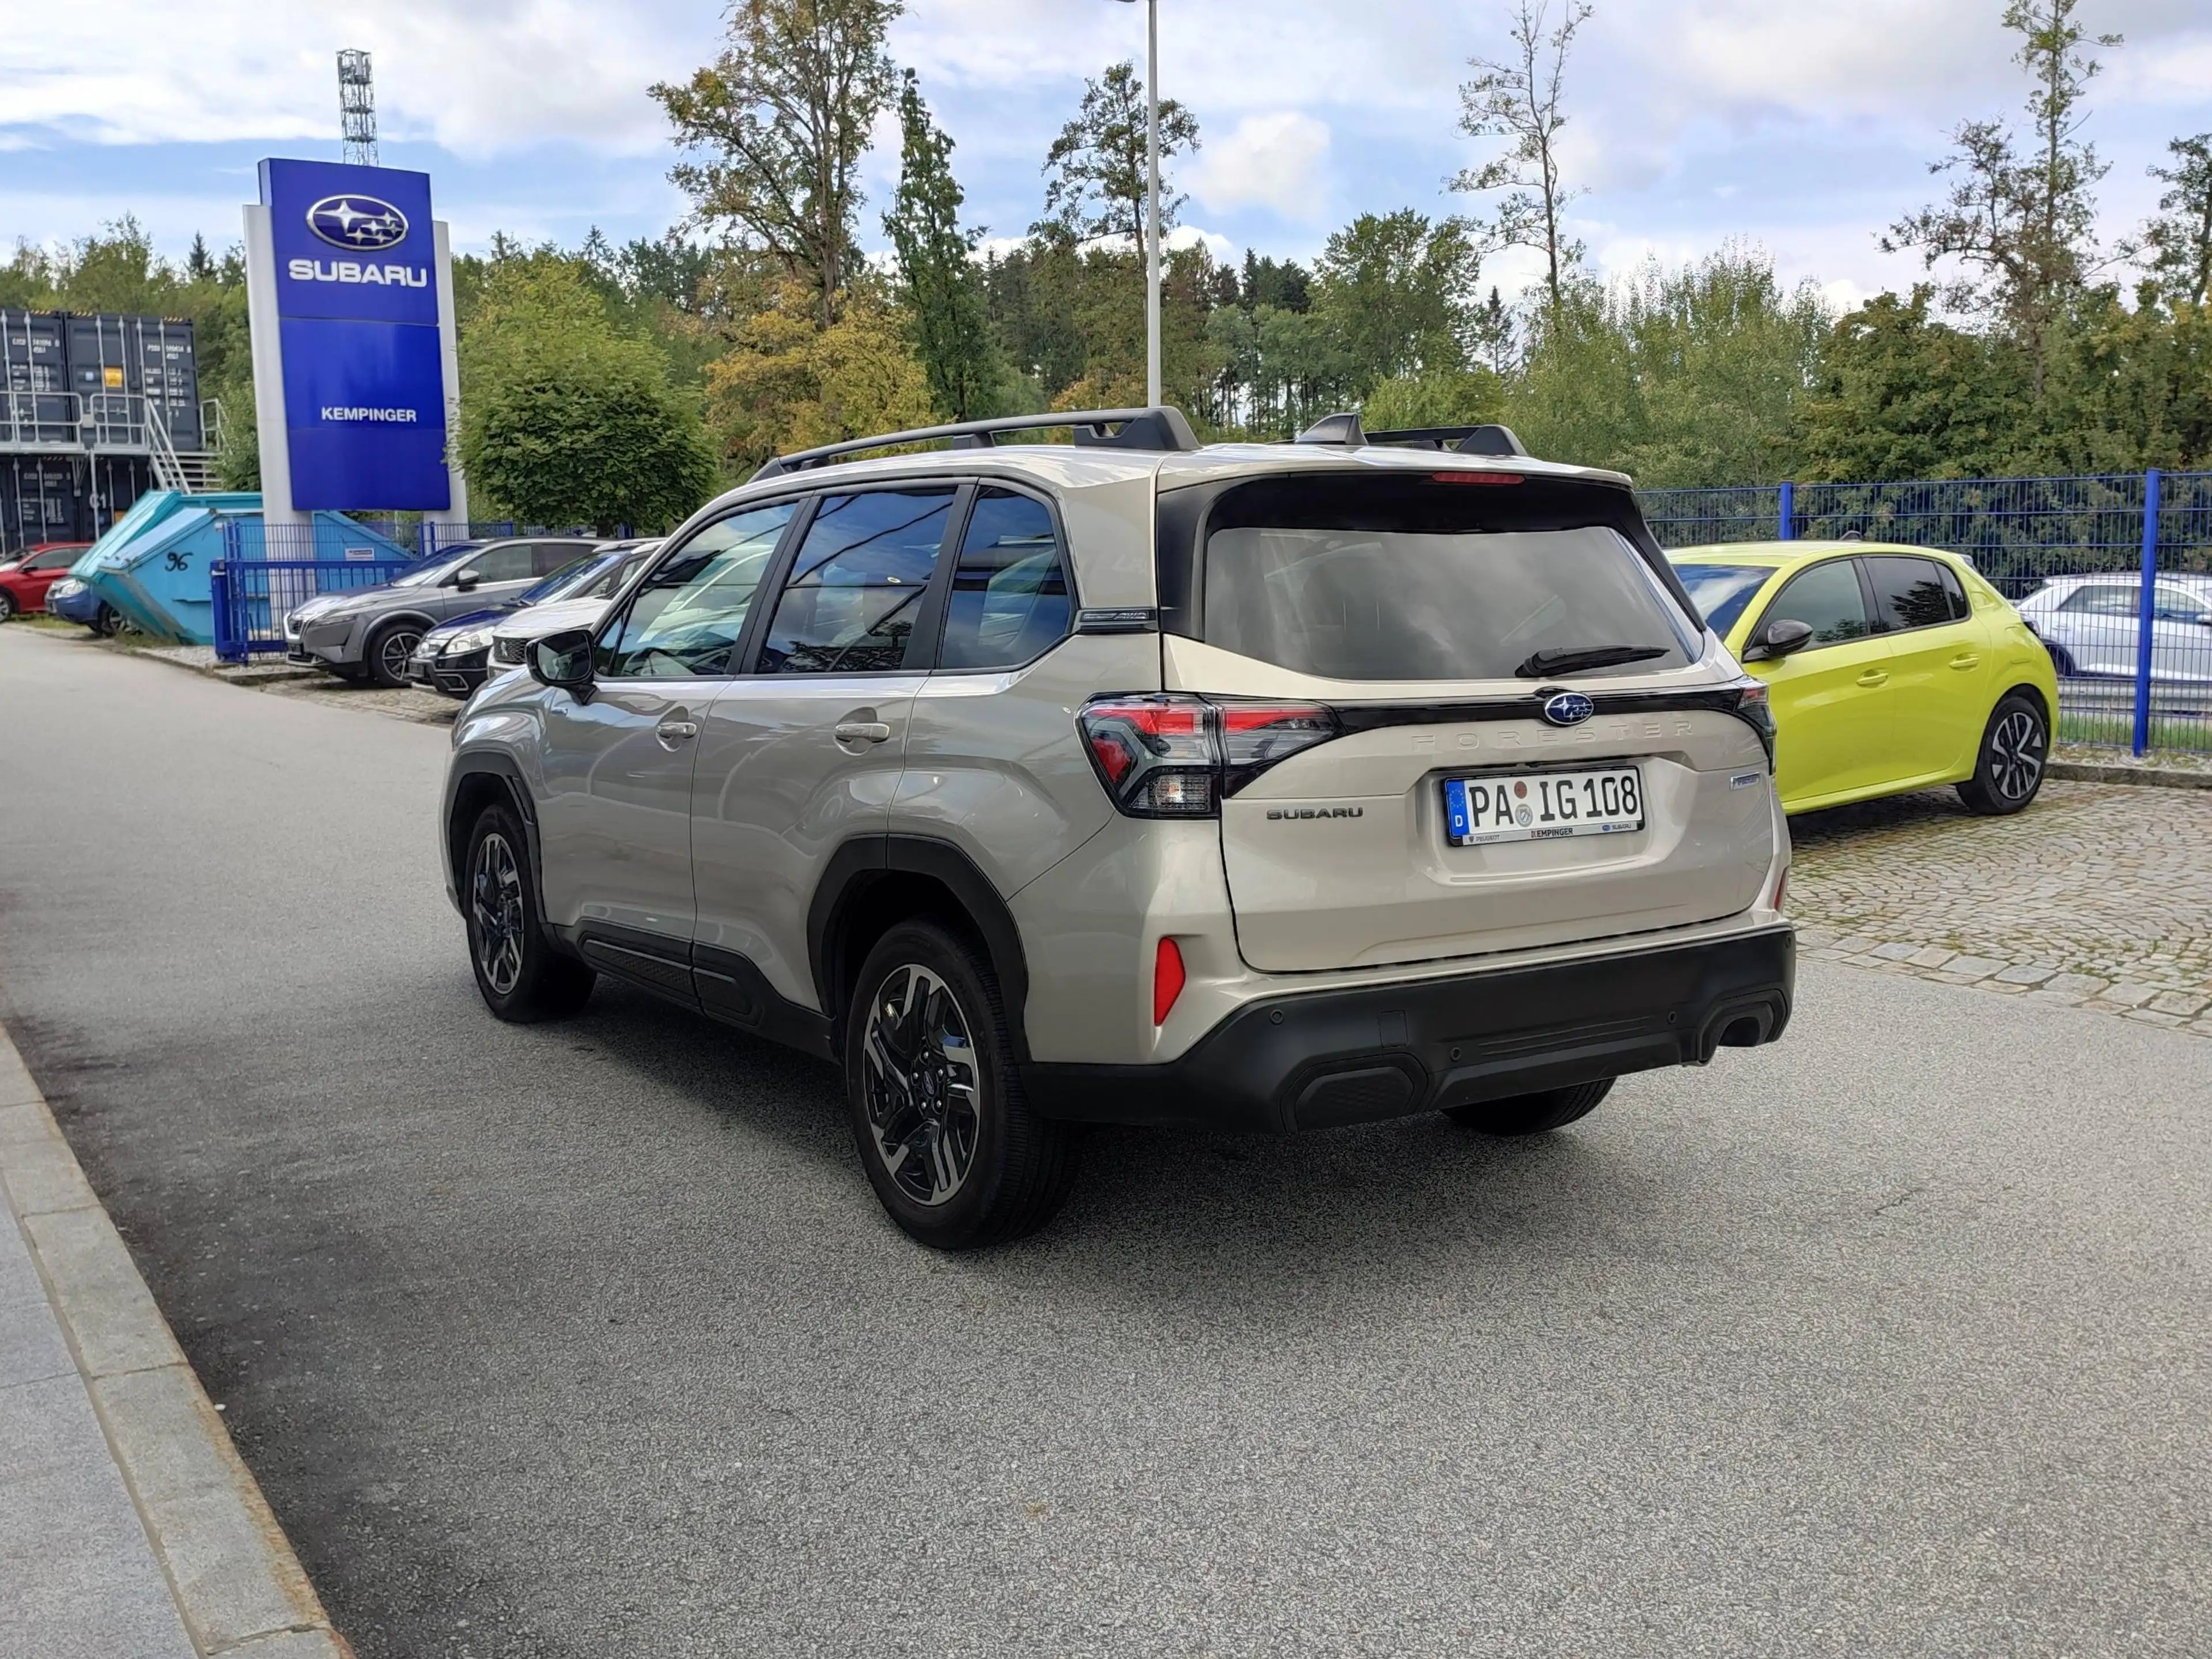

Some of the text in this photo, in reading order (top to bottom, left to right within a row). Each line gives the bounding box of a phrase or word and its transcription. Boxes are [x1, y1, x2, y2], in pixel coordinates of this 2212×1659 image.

[289, 259, 427, 287] SUBARU
[322, 407, 417, 422] KEMPINGER
[165, 552, 194, 571] 96
[1412, 721, 1693, 751] FORESTER
[1469, 775, 1637, 827] PA IG 108
[1266, 807, 1363, 820] SUBARU
[1455, 815, 1462, 827] D
[1531, 828, 1573, 838] KEMPINGER
